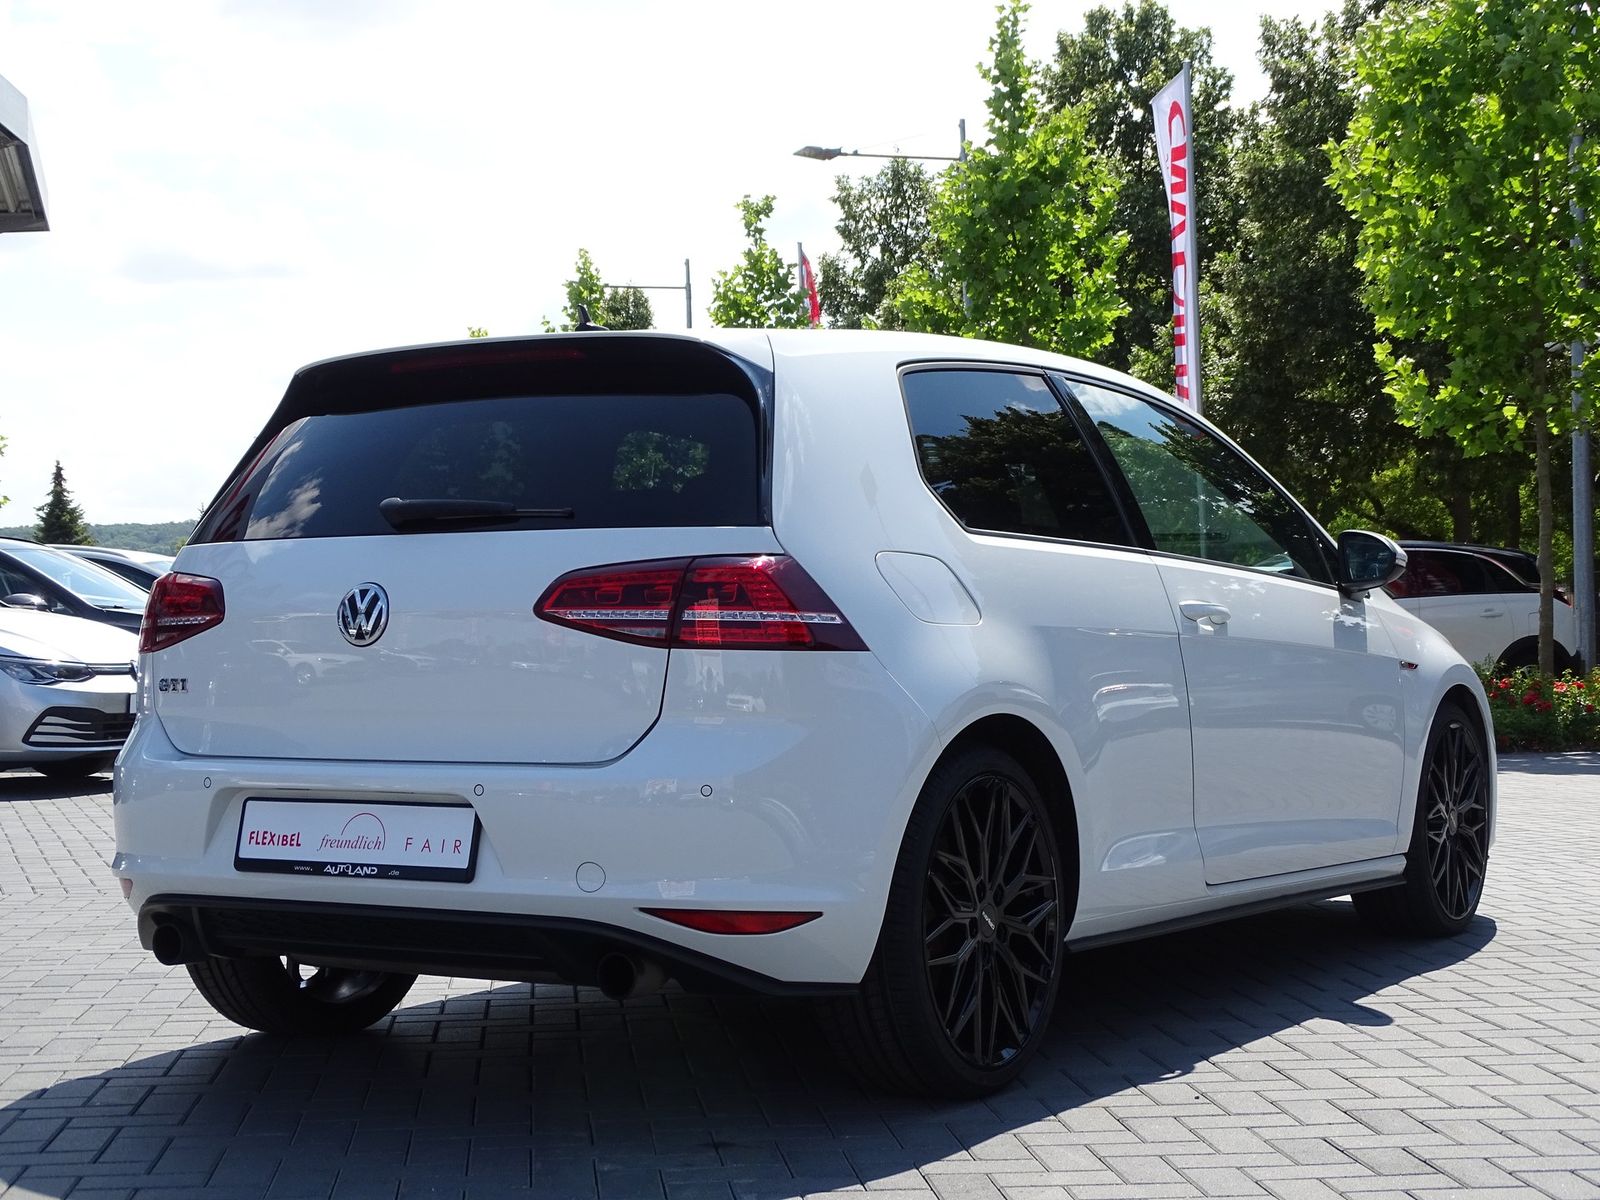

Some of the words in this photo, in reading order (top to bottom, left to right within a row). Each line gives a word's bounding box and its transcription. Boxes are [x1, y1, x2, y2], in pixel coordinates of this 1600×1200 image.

[158, 678, 188, 693] GTI
[248, 830, 302, 847] FLEXIBEL
[316, 833, 382, 852] freundlich
[404, 837, 462, 854] FAIR
[323, 863, 378, 877] AUTOLAND
